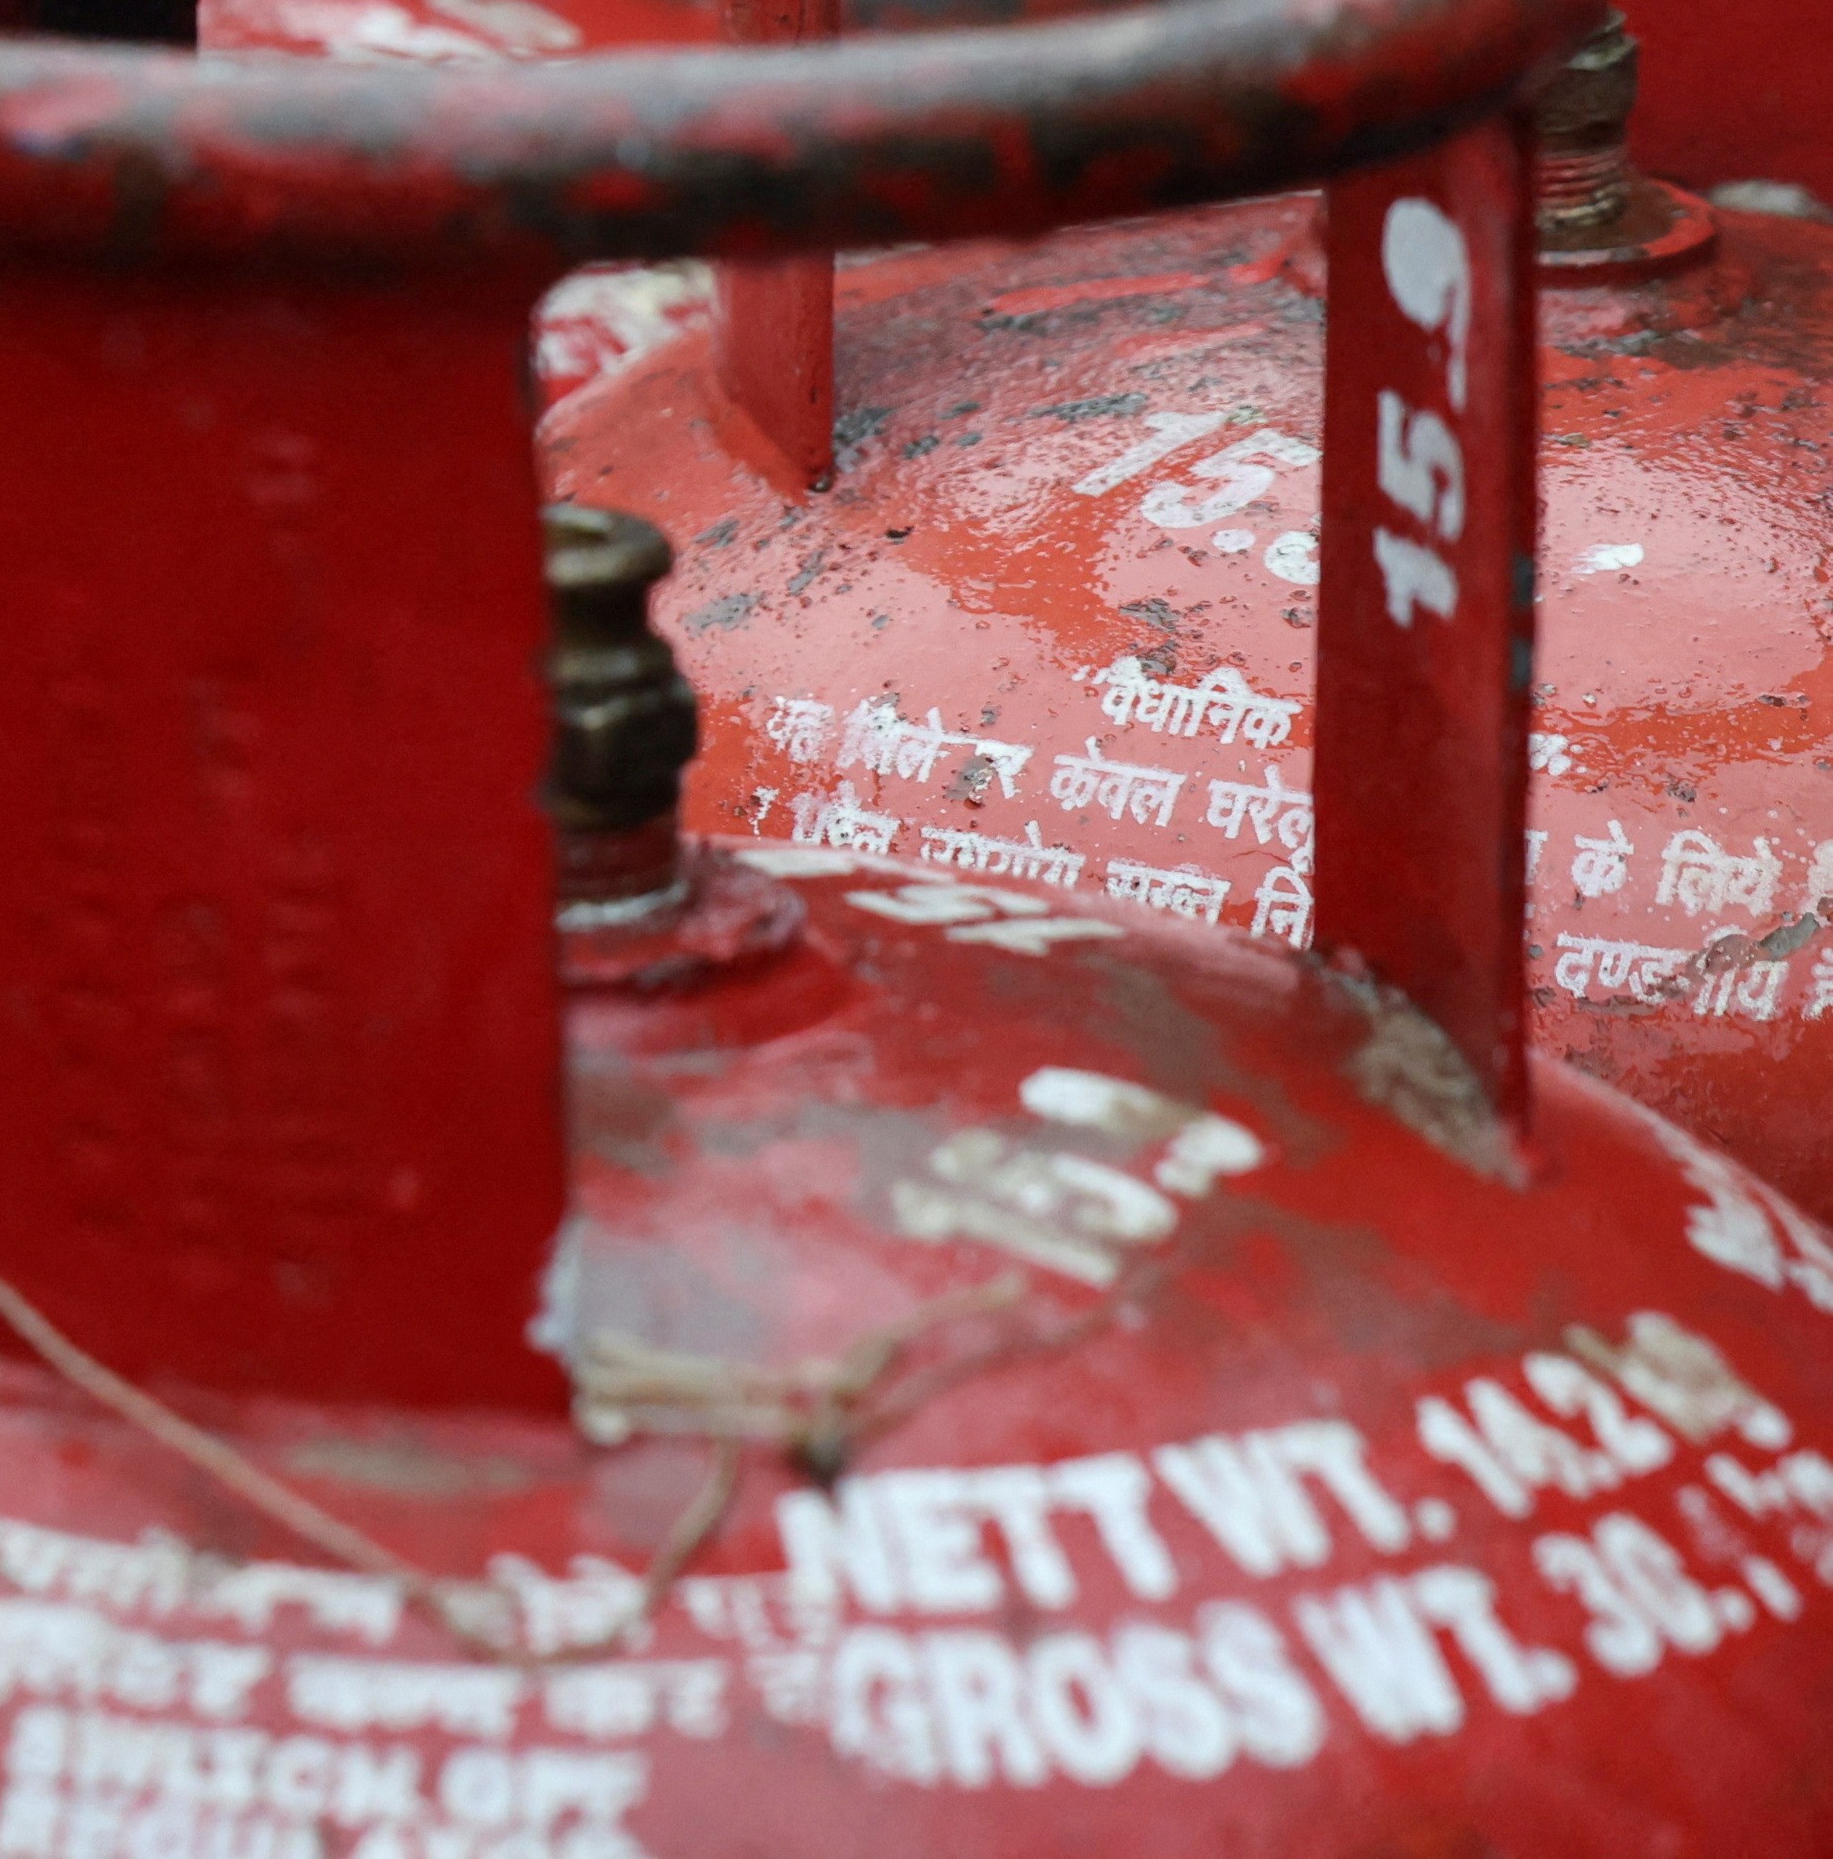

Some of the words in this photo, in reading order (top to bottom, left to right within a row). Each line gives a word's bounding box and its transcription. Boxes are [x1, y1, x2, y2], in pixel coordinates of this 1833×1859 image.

[1049, 735, 1188, 828] केवल
[776, 1455, 1179, 1614] NETT
[1151, 1418, 1460, 1578] WT.
[830, 1620, 1331, 1790] GROSS
